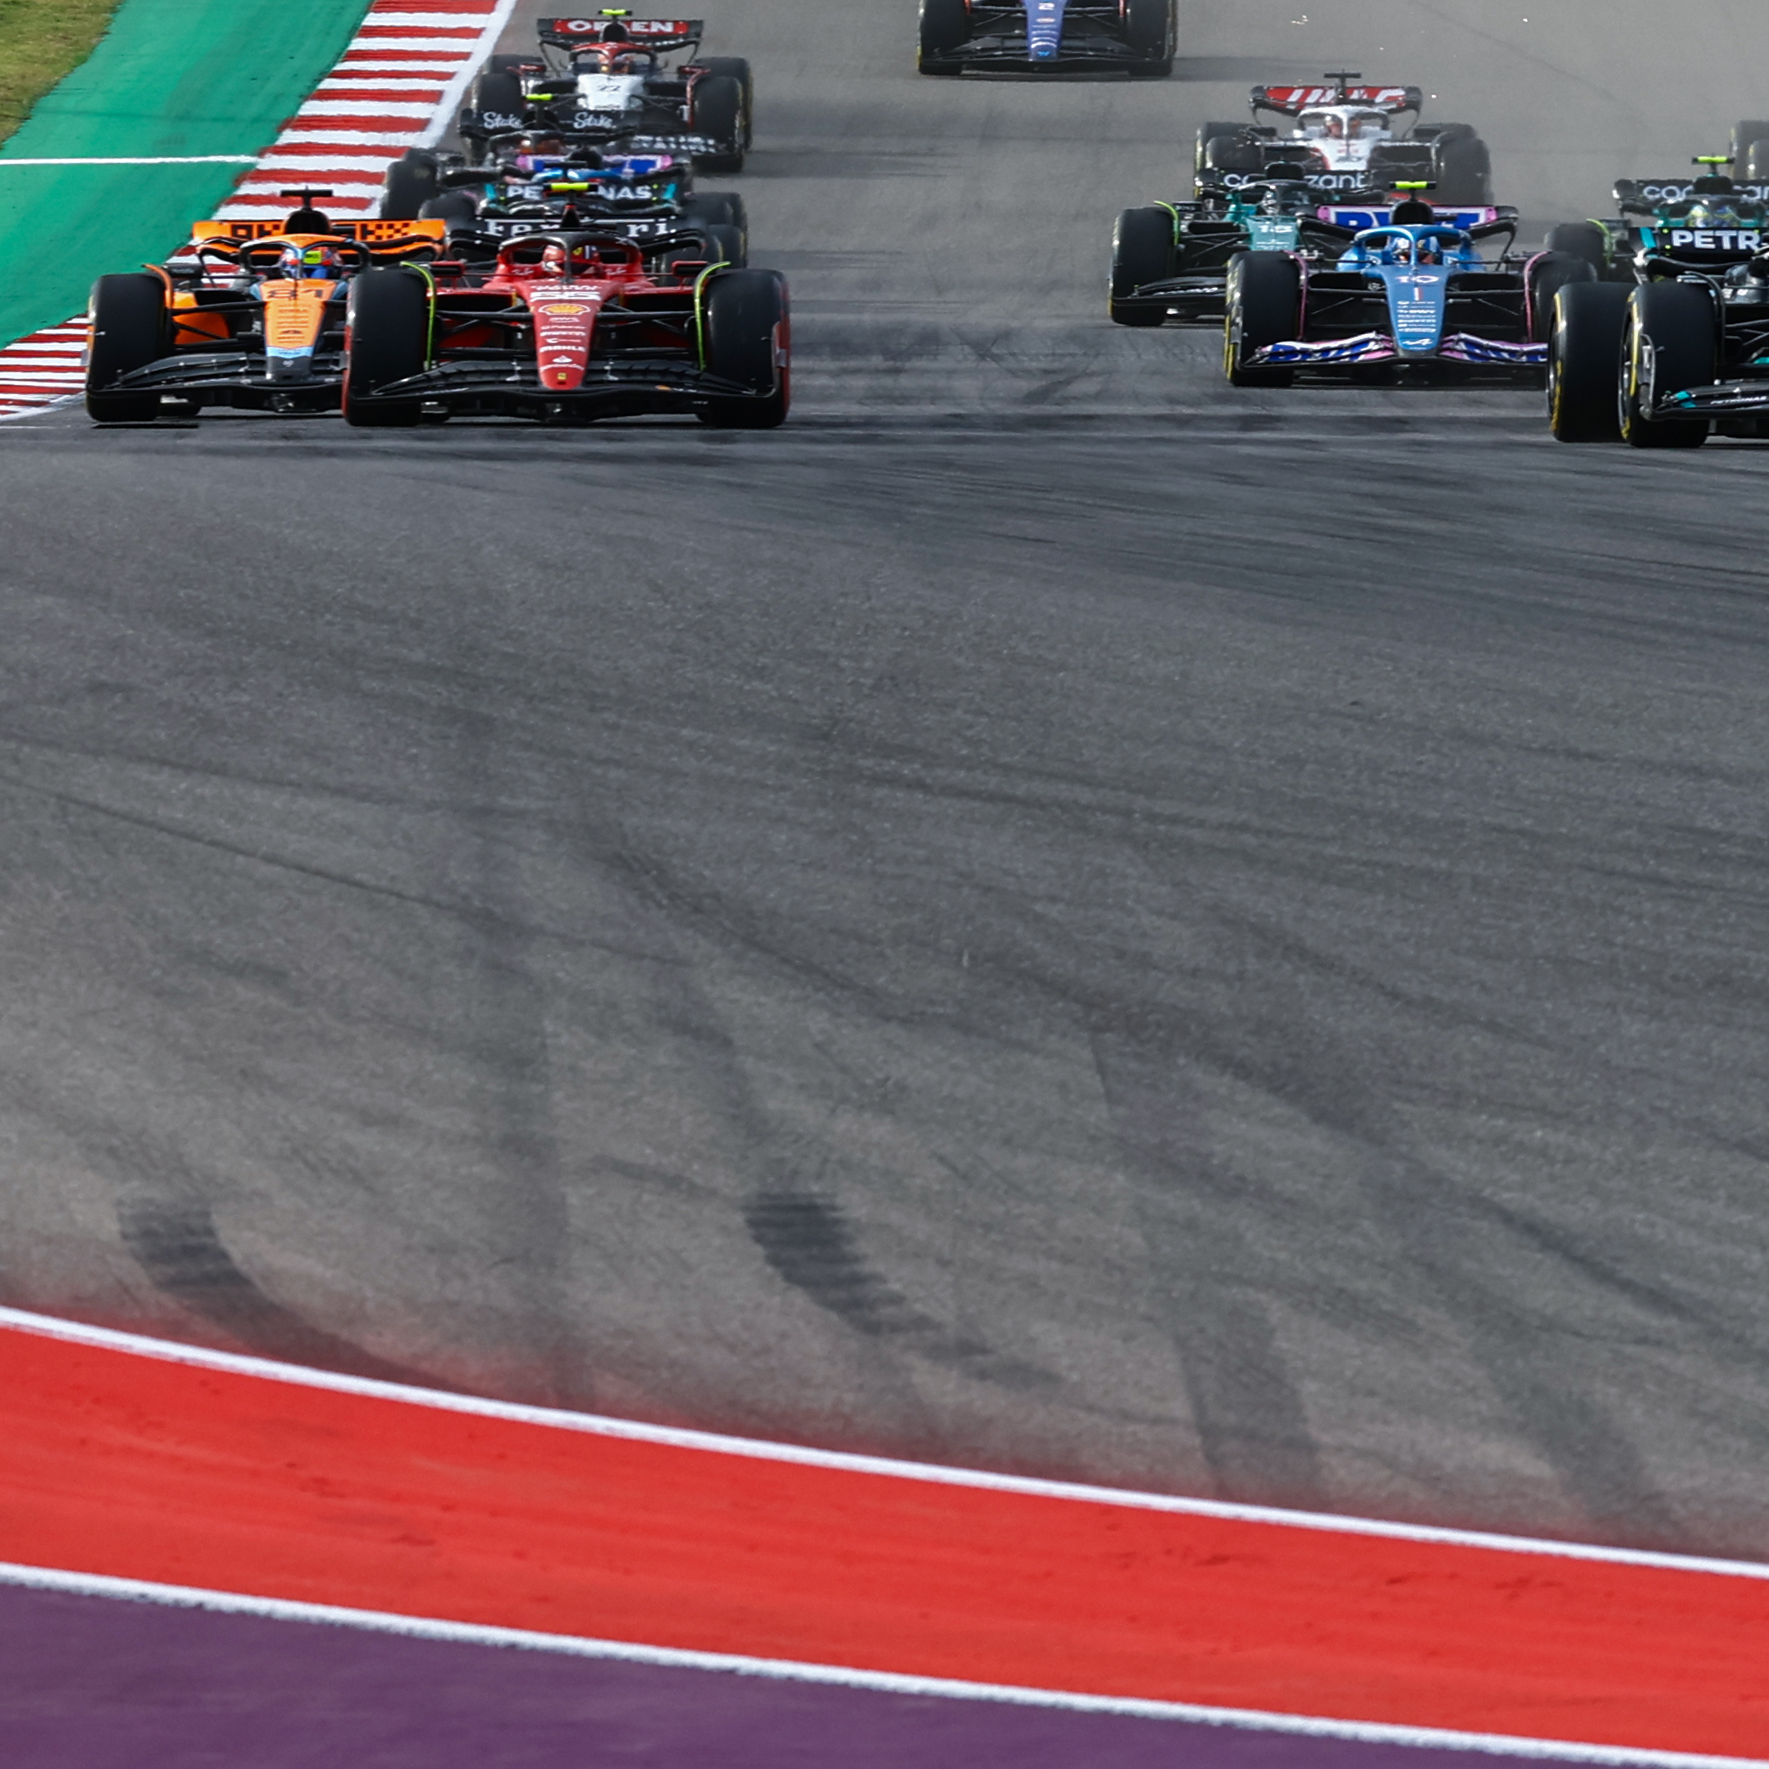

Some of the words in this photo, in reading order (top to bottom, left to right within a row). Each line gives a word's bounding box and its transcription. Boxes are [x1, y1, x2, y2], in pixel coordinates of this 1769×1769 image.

[568, 19, 675, 34] OEN
[1223, 173, 1370, 192] czant
[506, 184, 653, 201] PENAS
[484, 219, 671, 237] Feri
